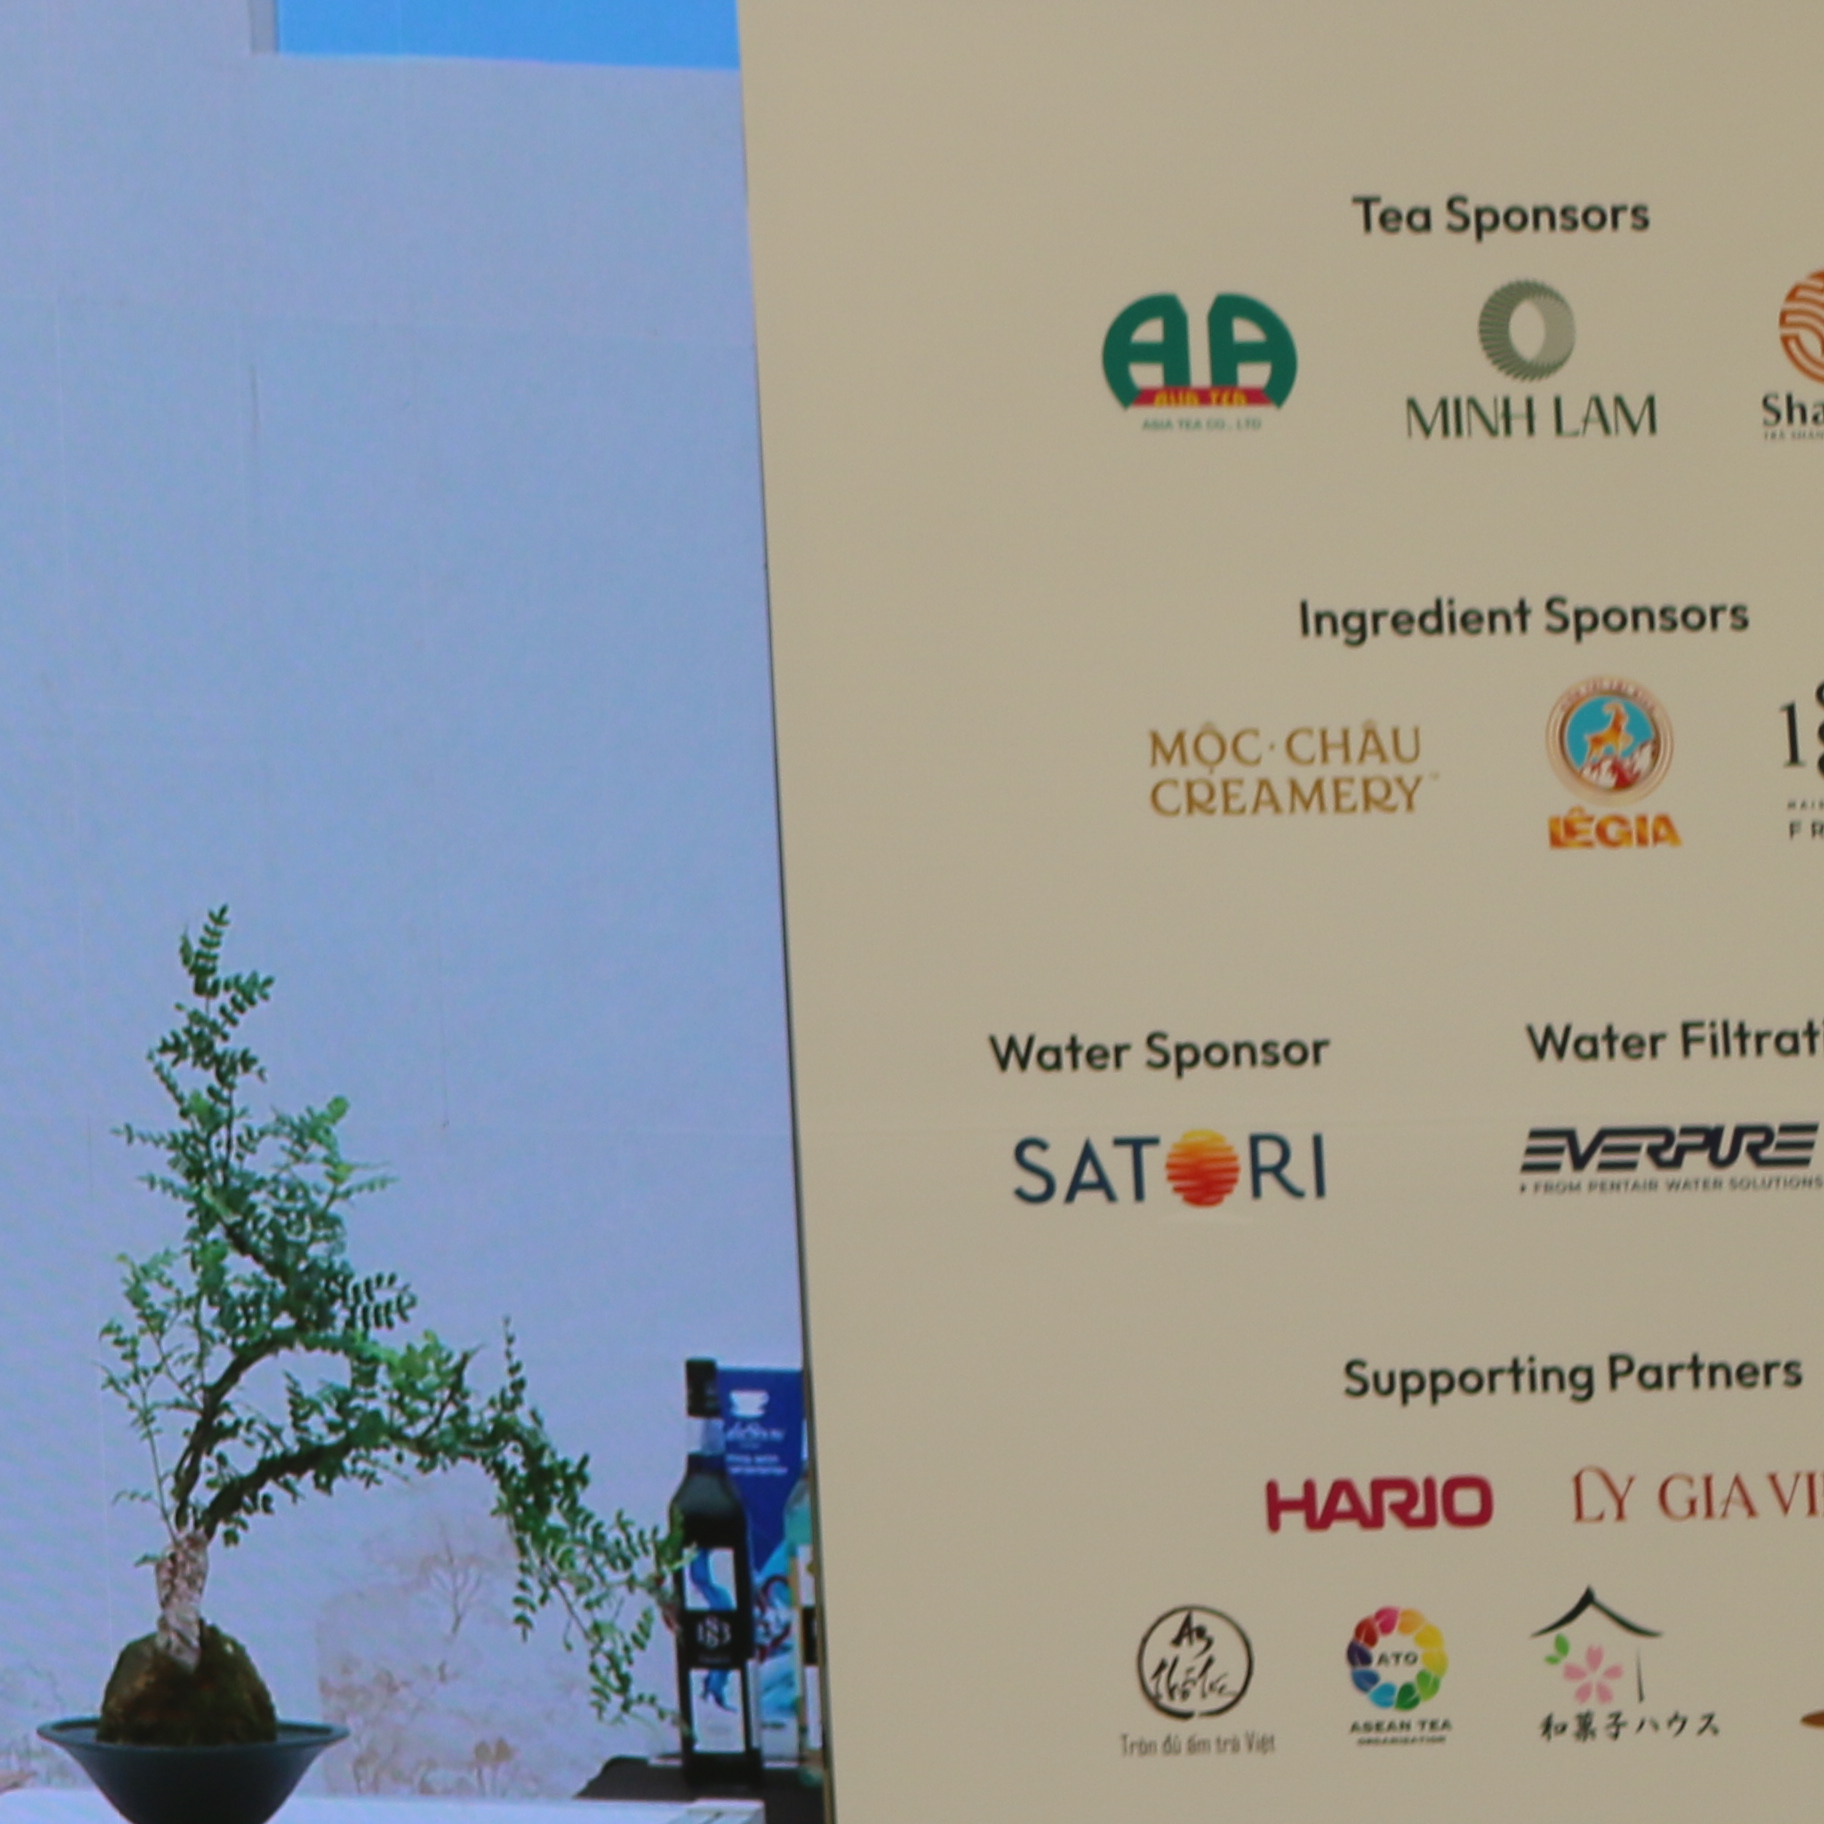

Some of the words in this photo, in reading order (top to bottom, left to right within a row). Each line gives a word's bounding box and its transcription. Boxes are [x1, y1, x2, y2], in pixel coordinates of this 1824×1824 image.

[1353, 197, 1431, 233] Tea
[1447, 196, 1649, 242] Sponsors
[1142, 418, 1174, 431] ASIA
[1177, 418, 1203, 430] TEA
[1236, 418, 1263, 430] LTD
[1407, 397, 1534, 437] MINH
[1554, 395, 1656, 436] LAM
[1301, 598, 1531, 647] Ingredient
[1546, 597, 1749, 643] Sponsors
[1149, 774, 1424, 817] CREAMERY
[990, 1035, 1130, 1071] Water
[1146, 1032, 1329, 1079] Sponsor
[1527, 1025, 1666, 1060] Water
[1520, 1122, 1820, 1173] EVERPURE
[1666, 1176, 1723, 1192] WATER
[1345, 1356, 1594, 1406] Supporting
[1609, 1354, 1802, 1390] Partners
[1265, 1475, 1494, 1534] HARIO
[1658, 1472, 1758, 1522] GIA
[1767, 1470, 1824, 1518] VI
[1376, 1652, 1418, 1666] ATO
[1350, 1720, 1412, 1733] ASEAN
[1418, 1718, 1452, 1731] TEA
[1539, 1710, 1722, 1743] 和菓子ハウス
